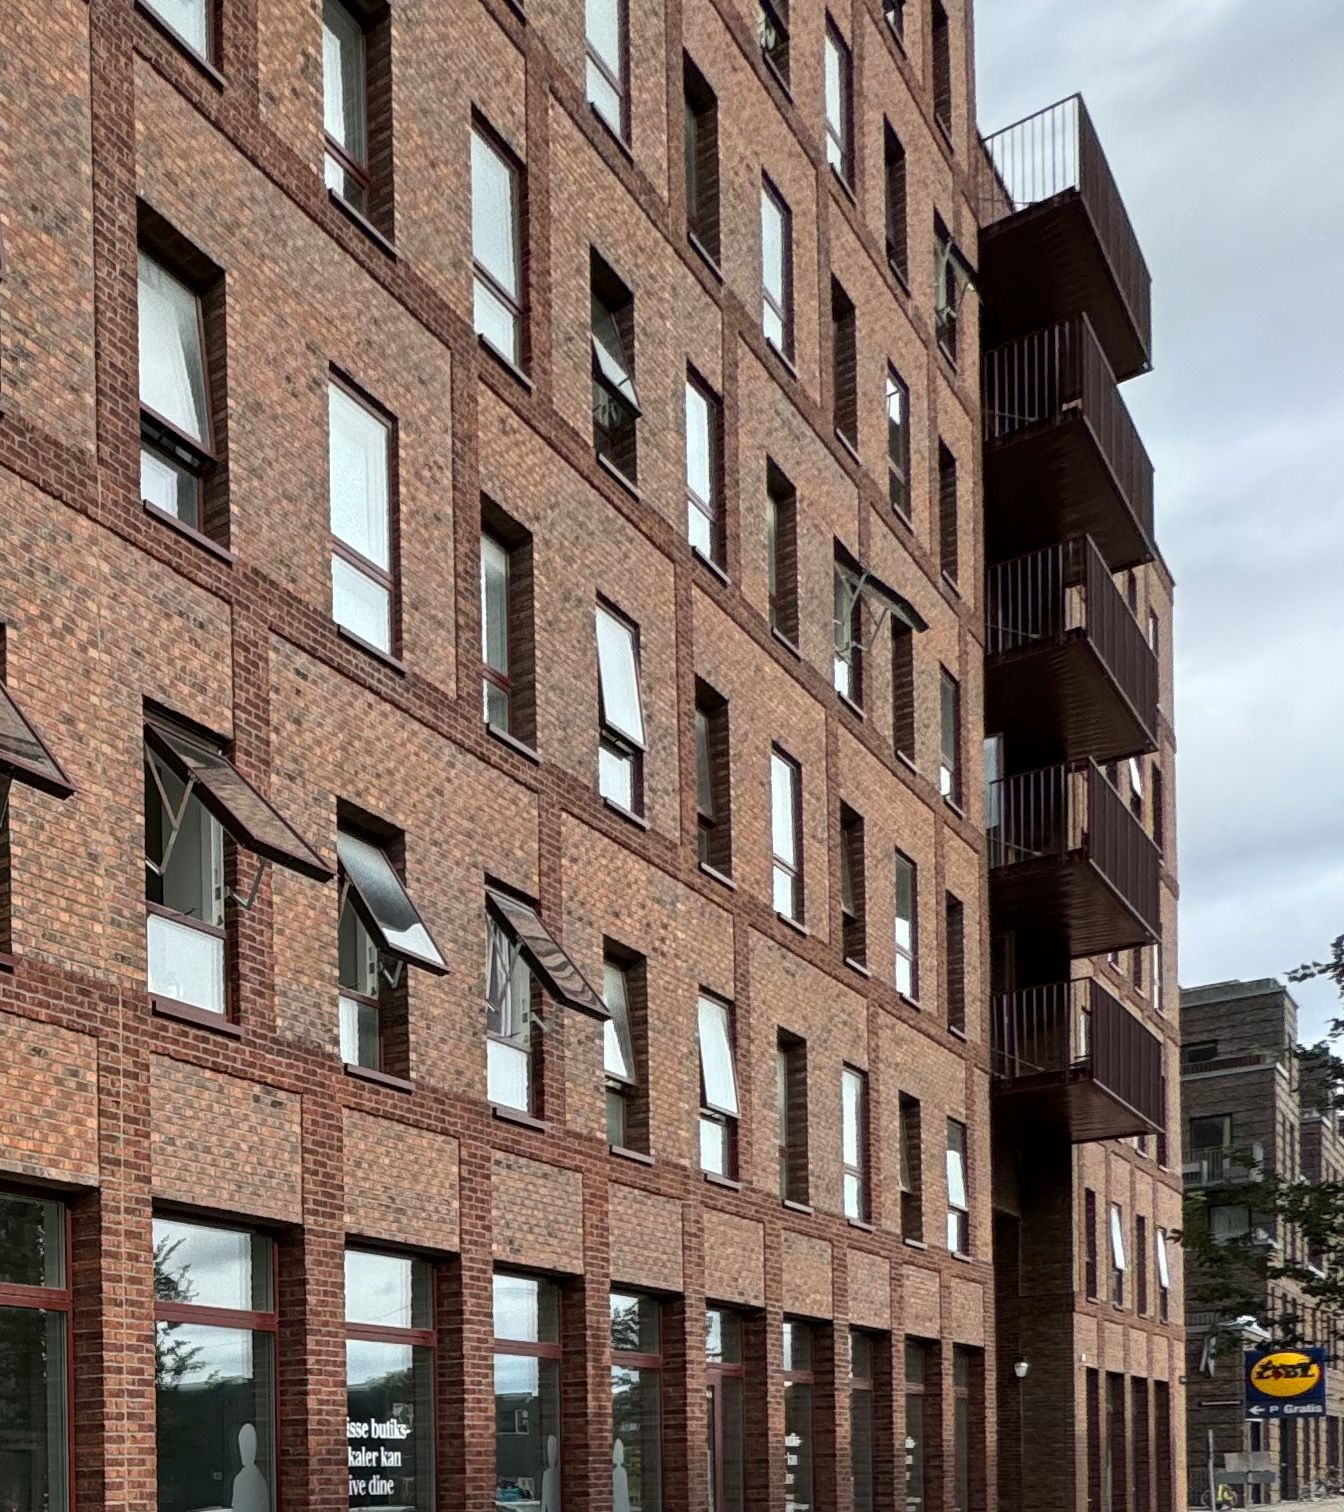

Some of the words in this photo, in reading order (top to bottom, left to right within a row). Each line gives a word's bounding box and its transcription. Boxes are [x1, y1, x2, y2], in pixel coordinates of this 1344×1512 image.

[1269, 1405, 1280, 1413] P
[1283, 1404, 1323, 1414] Gratis
[371, 1418, 413, 1439] butiks-
[380, 1446, 402, 1467] kan
[368, 1474, 394, 1495] dine
